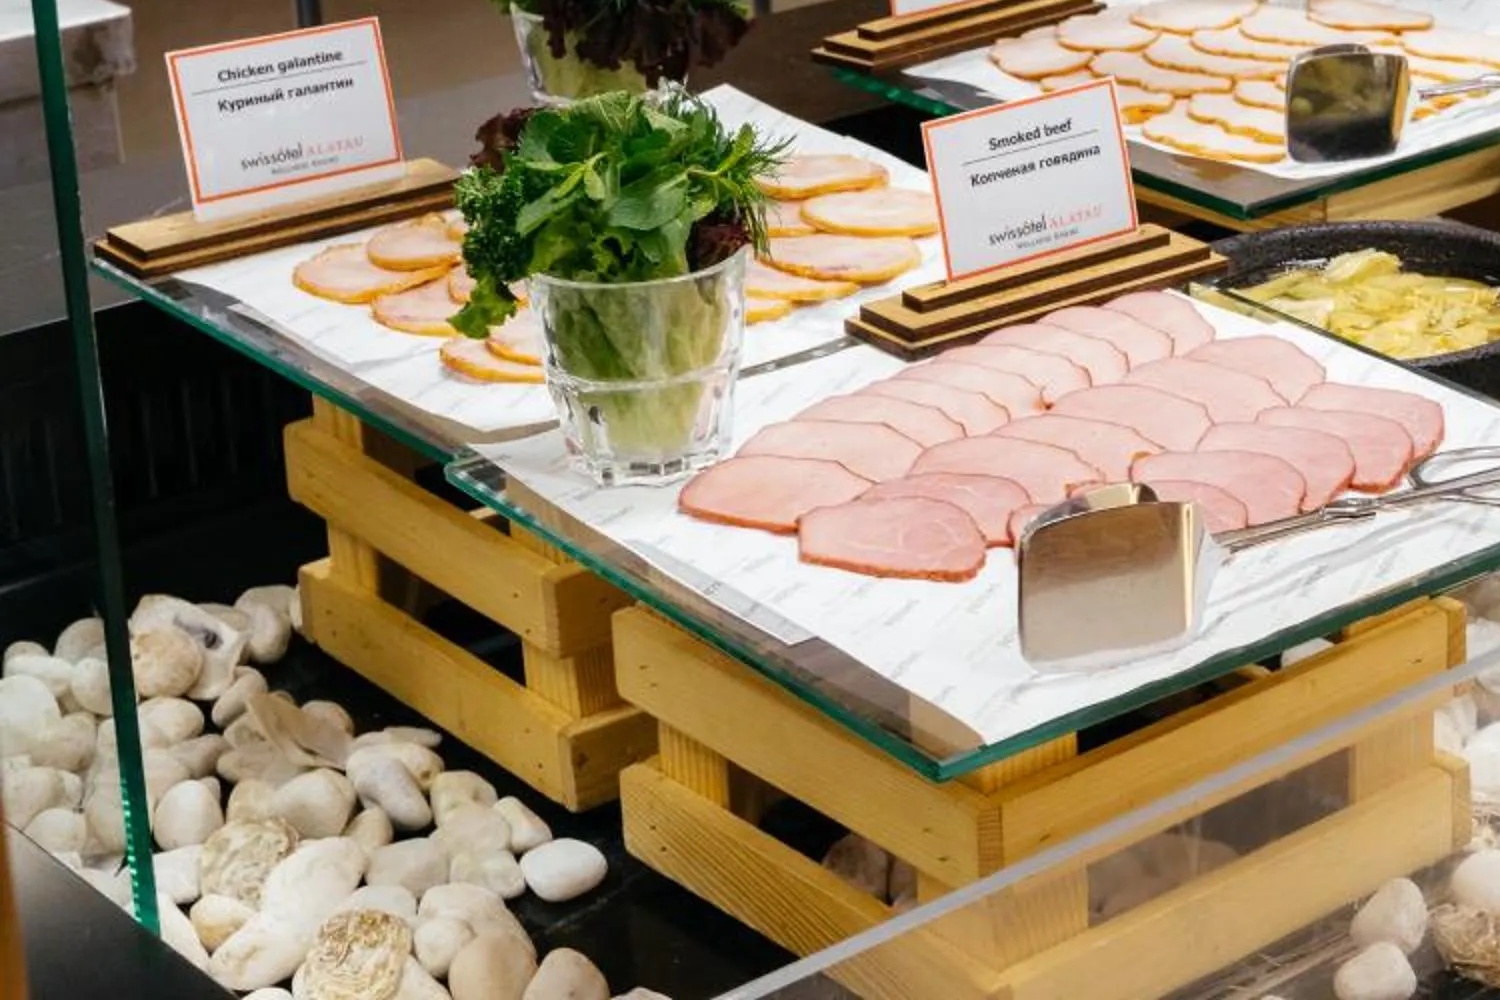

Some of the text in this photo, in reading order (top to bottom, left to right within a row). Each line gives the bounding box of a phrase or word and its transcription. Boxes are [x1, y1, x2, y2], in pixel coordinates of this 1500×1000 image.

[217, 50, 344, 83] Chicken galantine
[217, 77, 354, 113] Куриный галантин
[988, 117, 1073, 151] Smoked beef
[970, 144, 1101, 187] Копченая говядина
